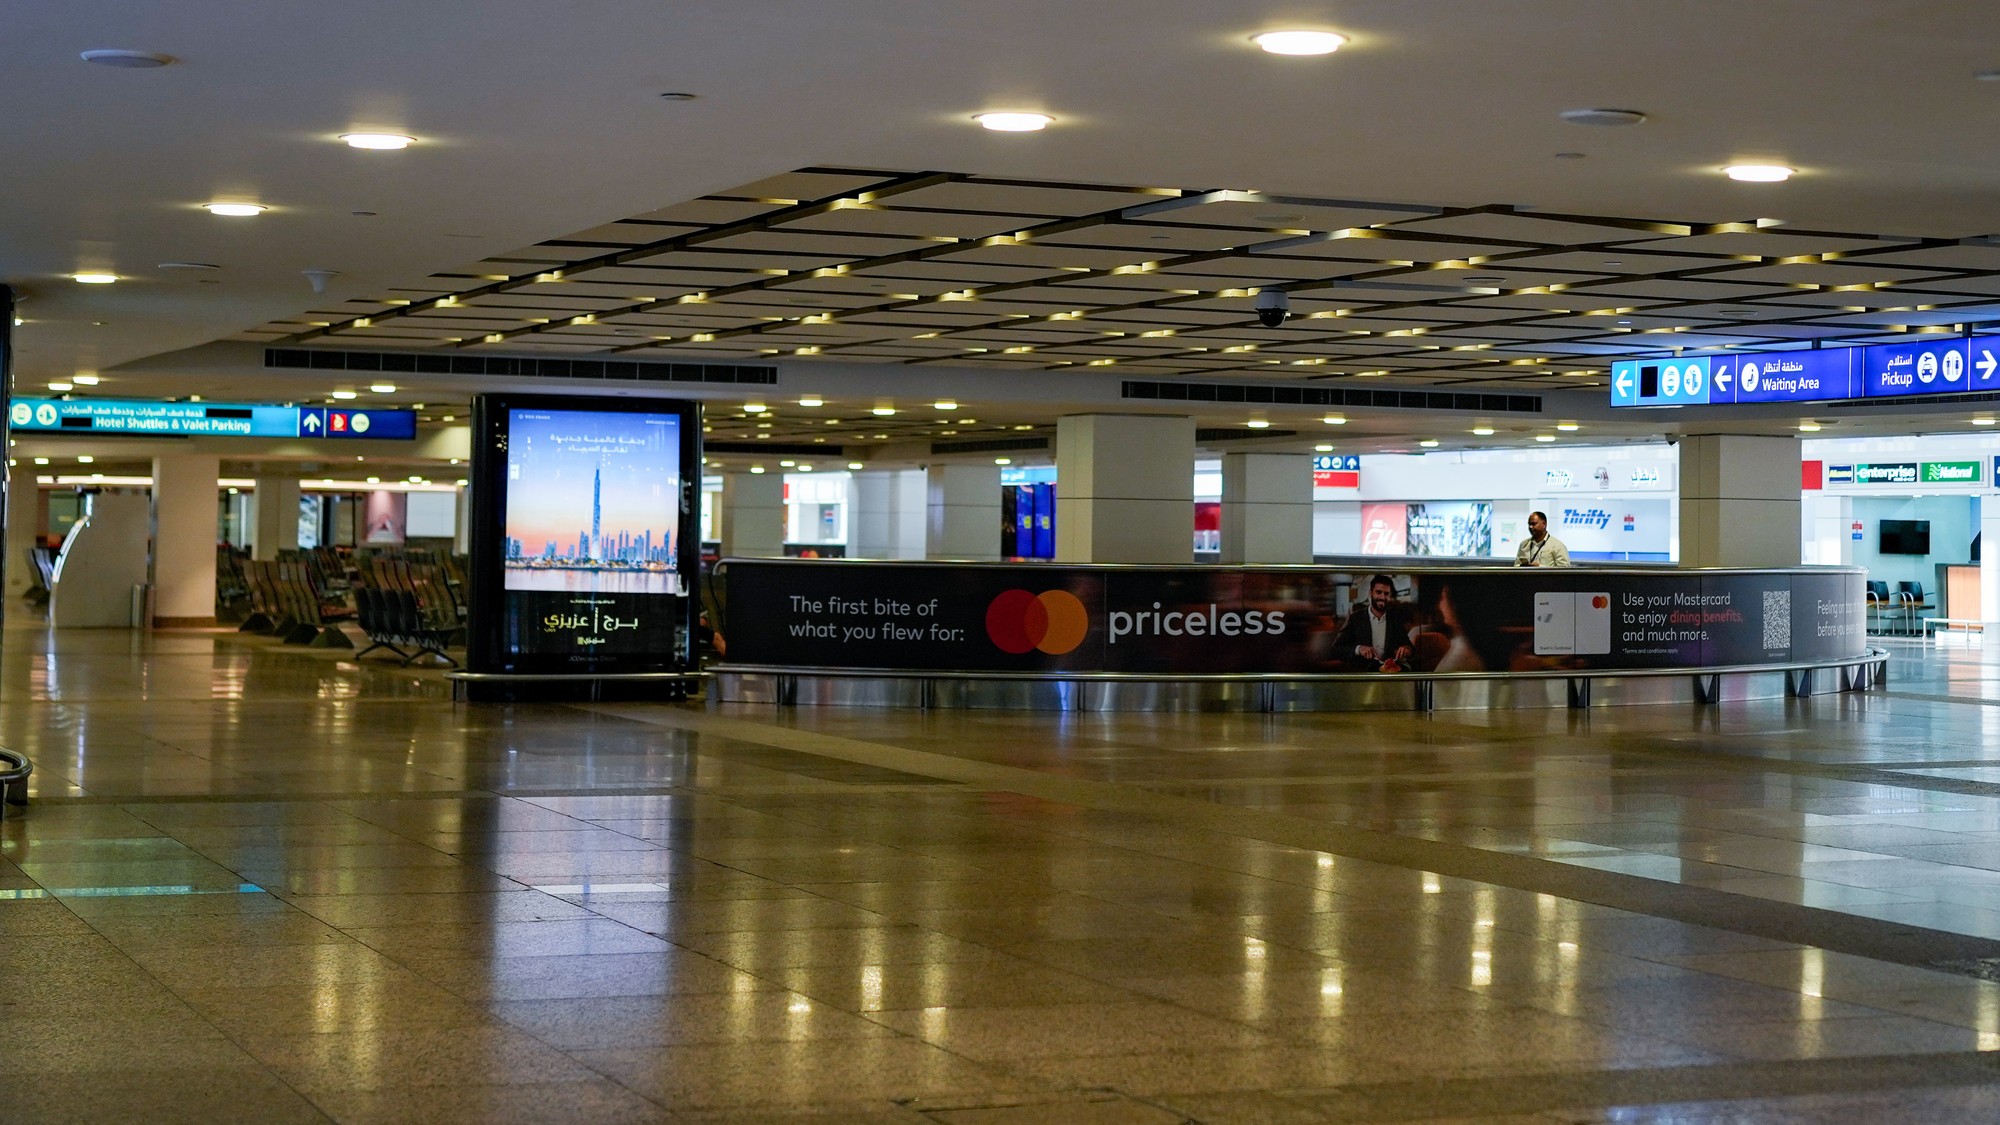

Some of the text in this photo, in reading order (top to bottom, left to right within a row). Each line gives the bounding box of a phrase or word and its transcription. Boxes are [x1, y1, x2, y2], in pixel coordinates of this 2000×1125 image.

[1781, 360, 1804, 372] منطقة
[1887, 353, 1913, 371] استلام
[1762, 376, 1820, 393] Waiting Area
[1881, 371, 1913, 388] Pickup
[96, 417, 252, 434] Hotel Shuttles & Valet Parking
[1857, 465, 1916, 482] enterprise
[1939, 465, 1973, 480] National
[1563, 509, 1612, 530] Thrifty
[789, 595, 939, 616] The first bite of
[1622, 592, 1731, 609] Use your Mastercard
[1817, 599, 1838, 618] Feeling
[1838, 602, 1845, 614] on
[543, 613, 639, 631] برج عزيزي
[1109, 602, 1286, 644] priceless
[1622, 608, 1744, 627] to enjoy dining benefits,
[789, 620, 965, 643] what you flew for:
[1622, 627, 1710, 641] and much more.
[1817, 620, 1837, 637] before
[1837, 624, 1846, 639] you
